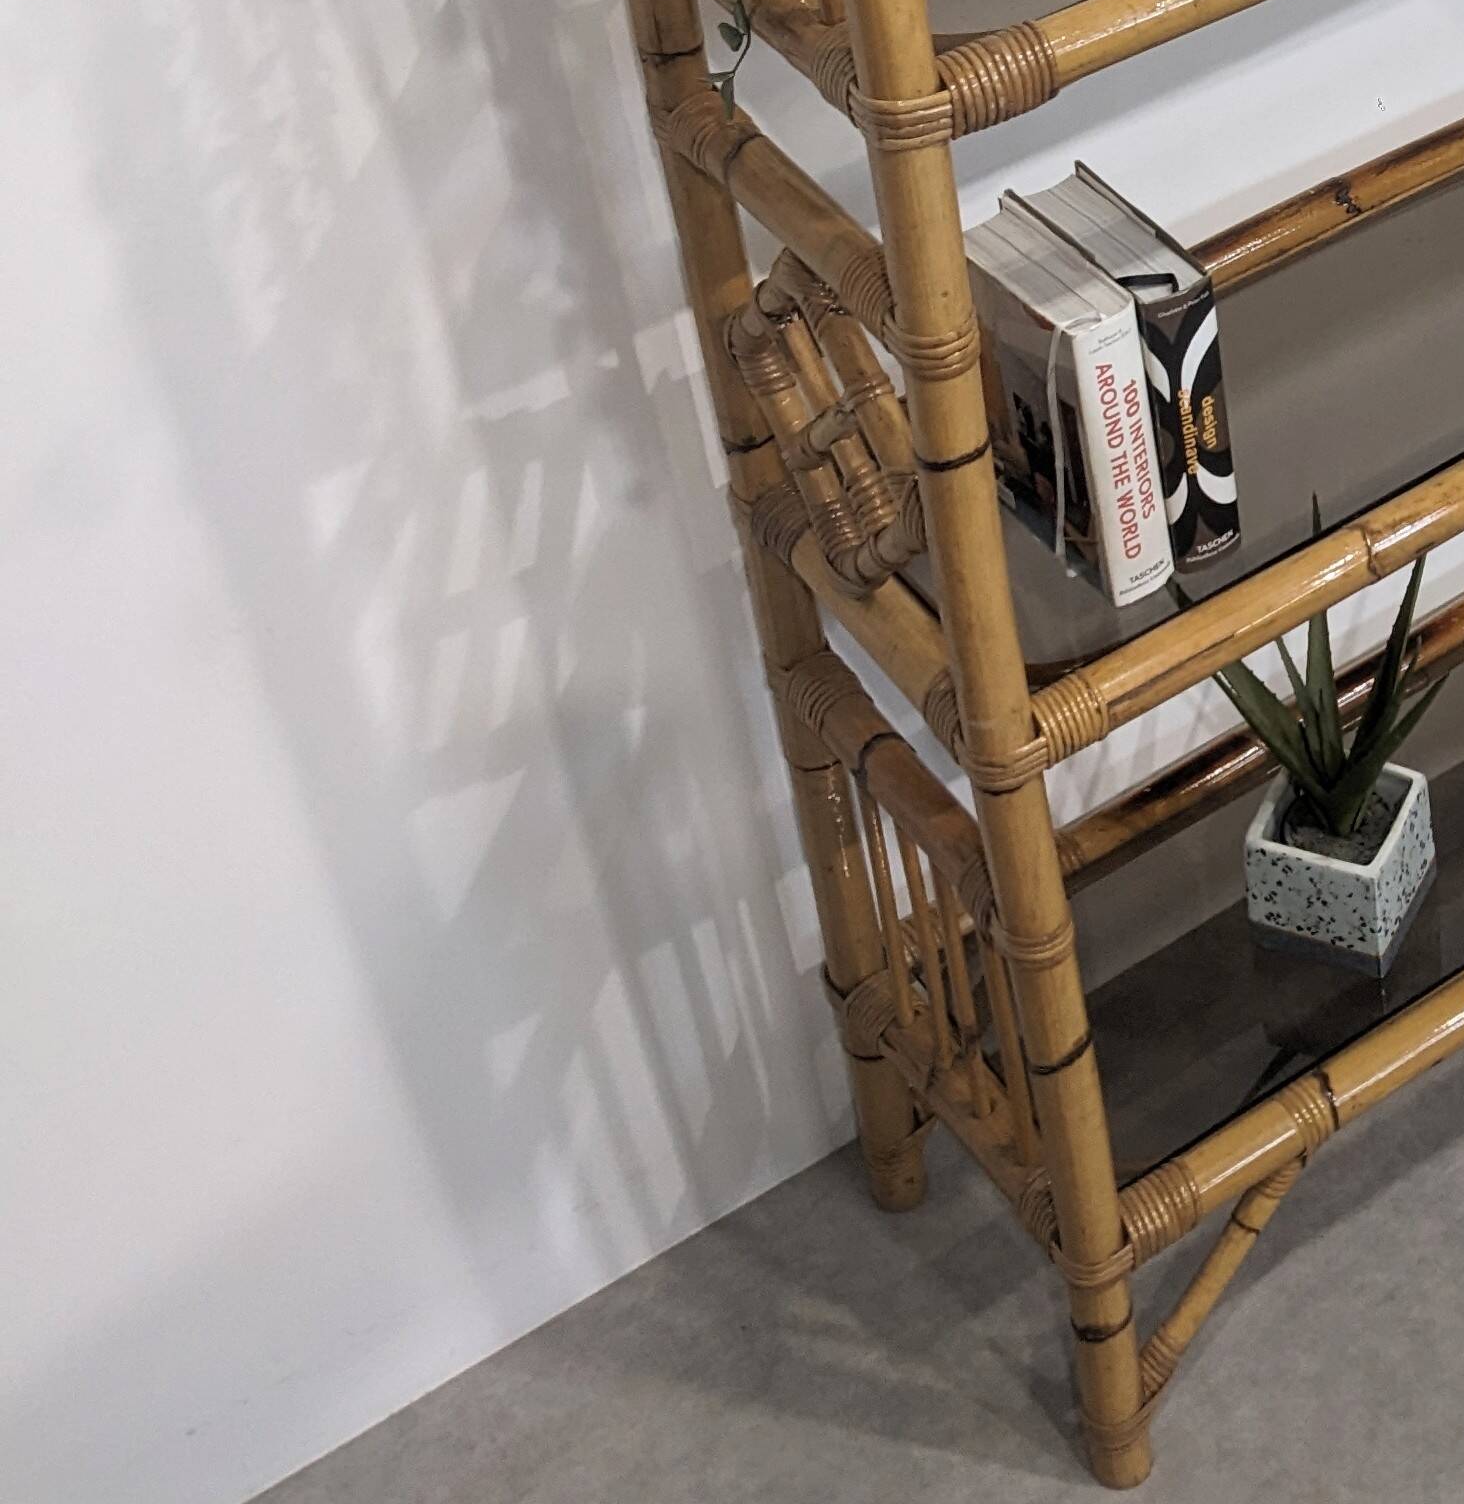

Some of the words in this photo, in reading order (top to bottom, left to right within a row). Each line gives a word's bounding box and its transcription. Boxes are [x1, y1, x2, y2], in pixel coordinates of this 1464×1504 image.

[1095, 363, 1125, 449] AROUND
[1122, 378, 1140, 418] 100
[1202, 396, 1217, 449] design
[1110, 450, 1131, 490] THE
[1129, 417, 1156, 520] INTERIORS
[1116, 489, 1142, 560] WORLD
[1197, 529, 1234, 555] TASCHEN
[1129, 558, 1165, 584] TASCHEN
